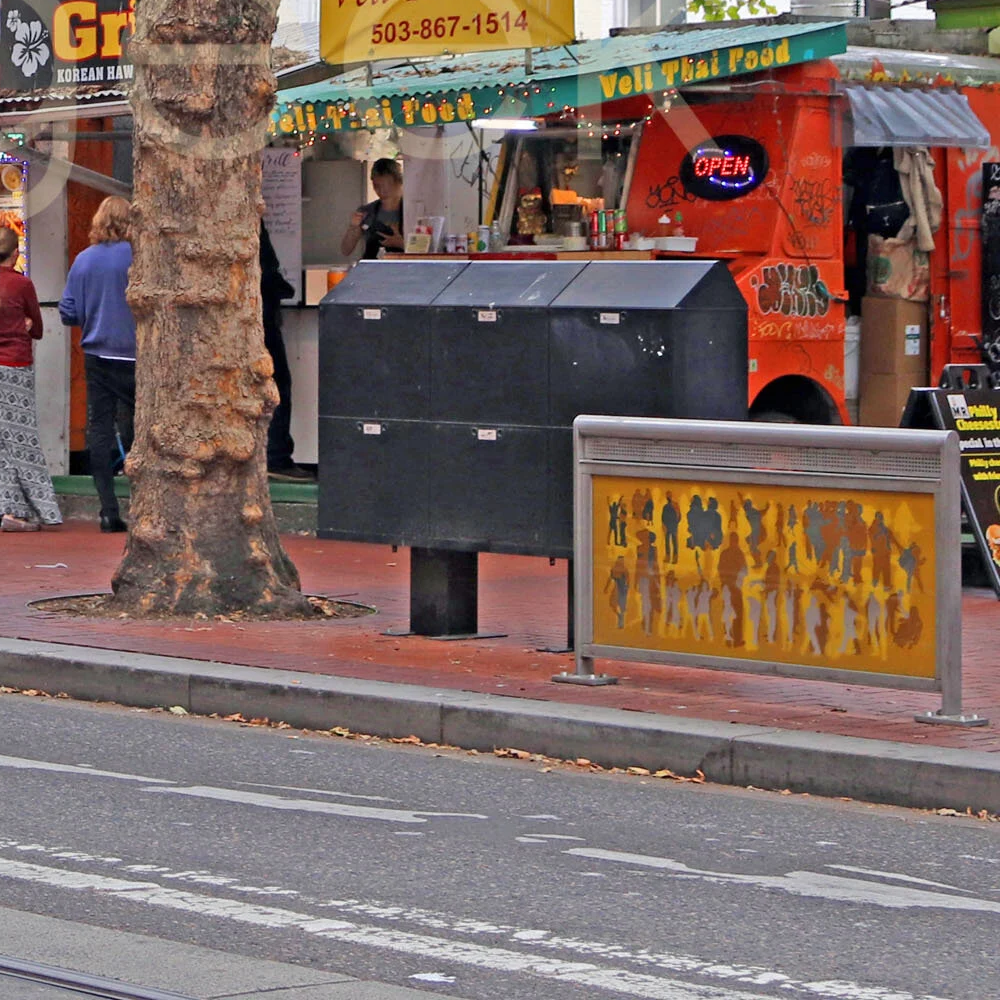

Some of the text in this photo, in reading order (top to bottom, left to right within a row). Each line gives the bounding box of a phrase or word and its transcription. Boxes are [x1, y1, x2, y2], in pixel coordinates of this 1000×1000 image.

[371, 9, 529, 45] 503-867-1514
[57, 66, 104, 84] KOREAN
[599, 37, 791, 99] Veli Thai Food
[403, 93, 477, 125] Food
[694, 155, 750, 177] OPEN
